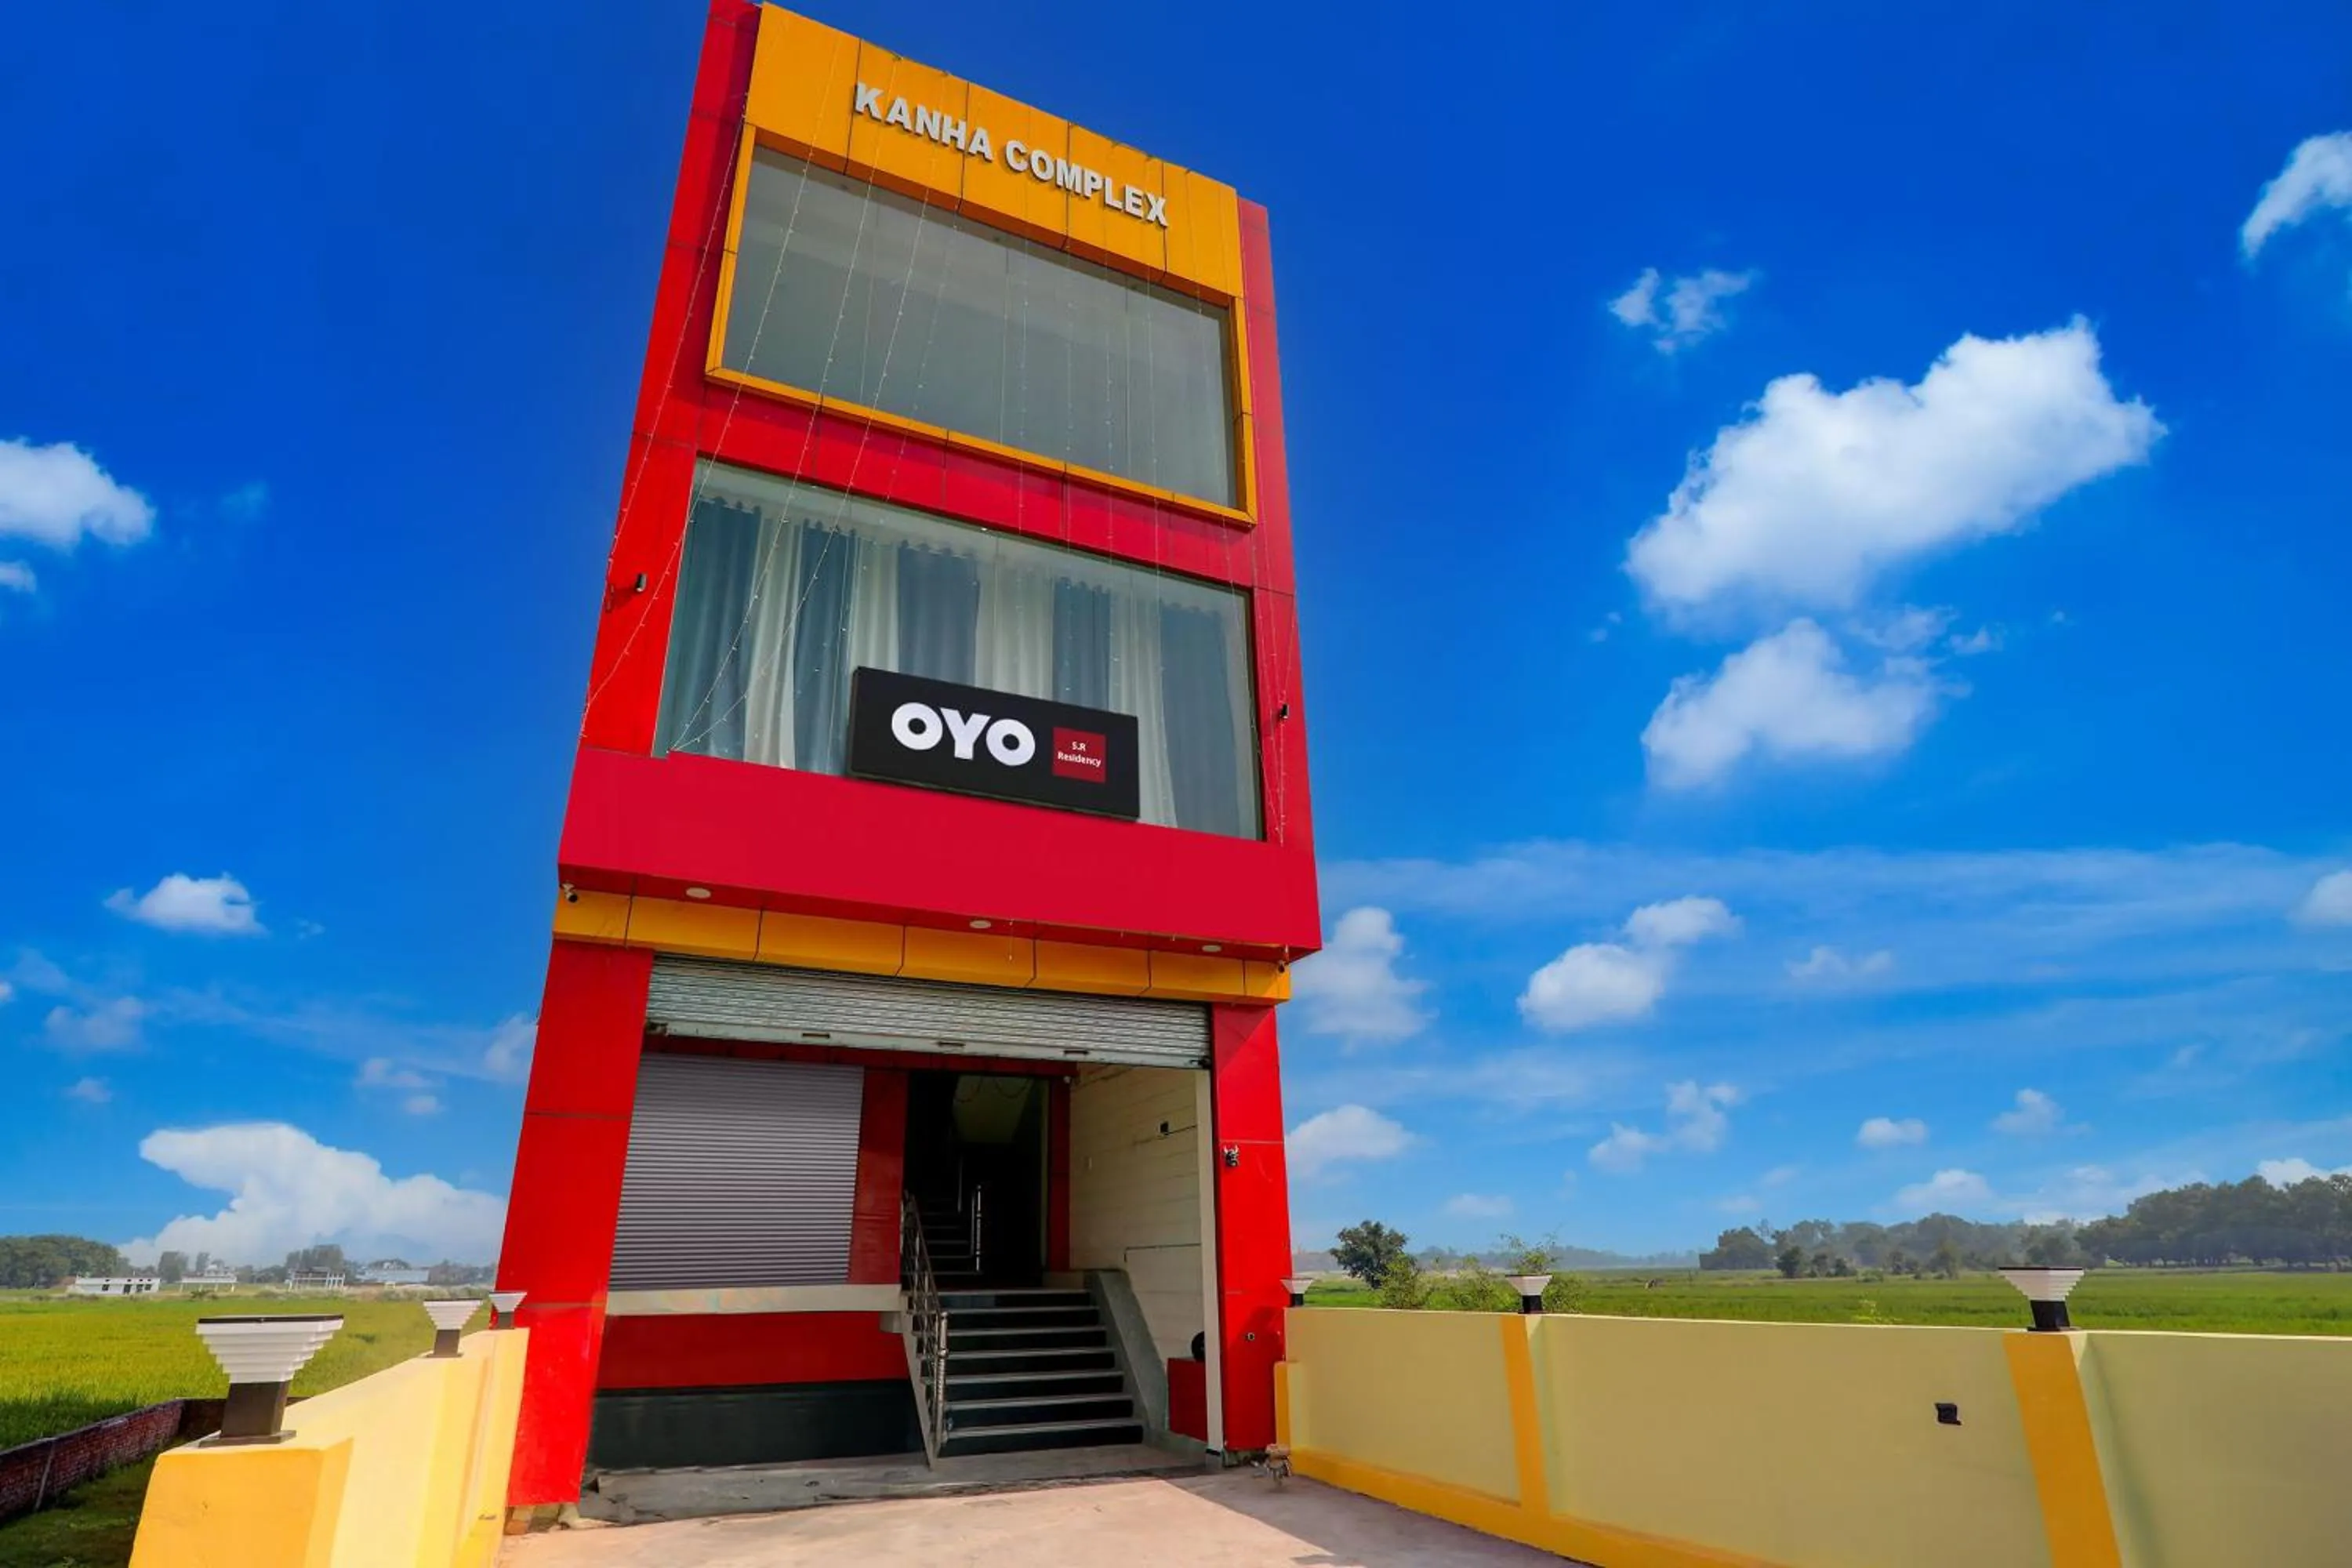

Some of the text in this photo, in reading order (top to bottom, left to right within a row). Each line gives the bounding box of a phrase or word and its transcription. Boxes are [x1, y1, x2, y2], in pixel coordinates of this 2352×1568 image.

[855, 82, 1168, 227] KANHA COMPLEX
[891, 702, 1036, 767] OYO
[1058, 751, 1102, 768] Residency
